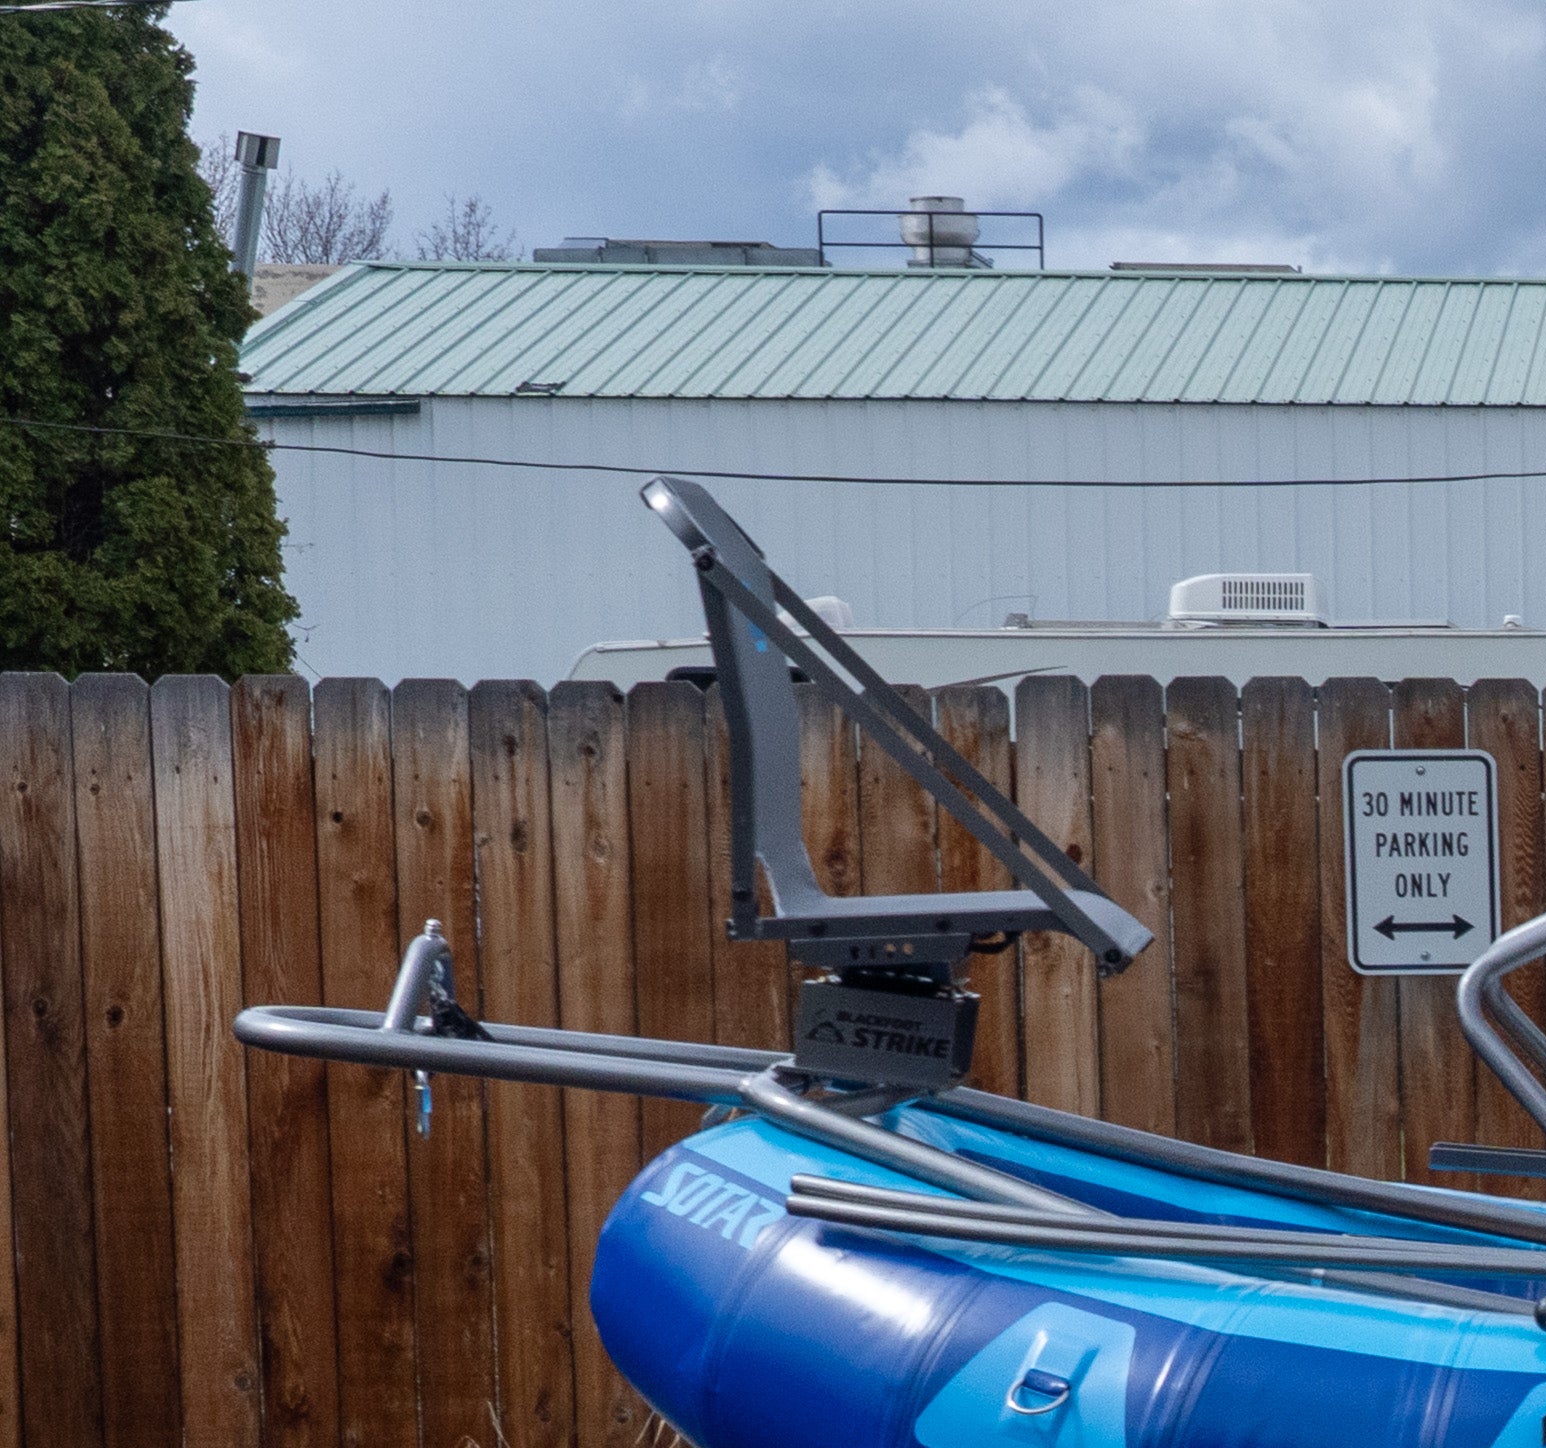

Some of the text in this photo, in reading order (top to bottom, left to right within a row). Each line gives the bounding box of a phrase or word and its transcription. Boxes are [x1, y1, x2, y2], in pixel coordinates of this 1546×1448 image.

[1362, 791, 1480, 817] 30 MINUTE
[1375, 832, 1469, 857] PARKING
[1395, 872, 1452, 898] ONLY
[850, 1027, 951, 1059] STRIKE
